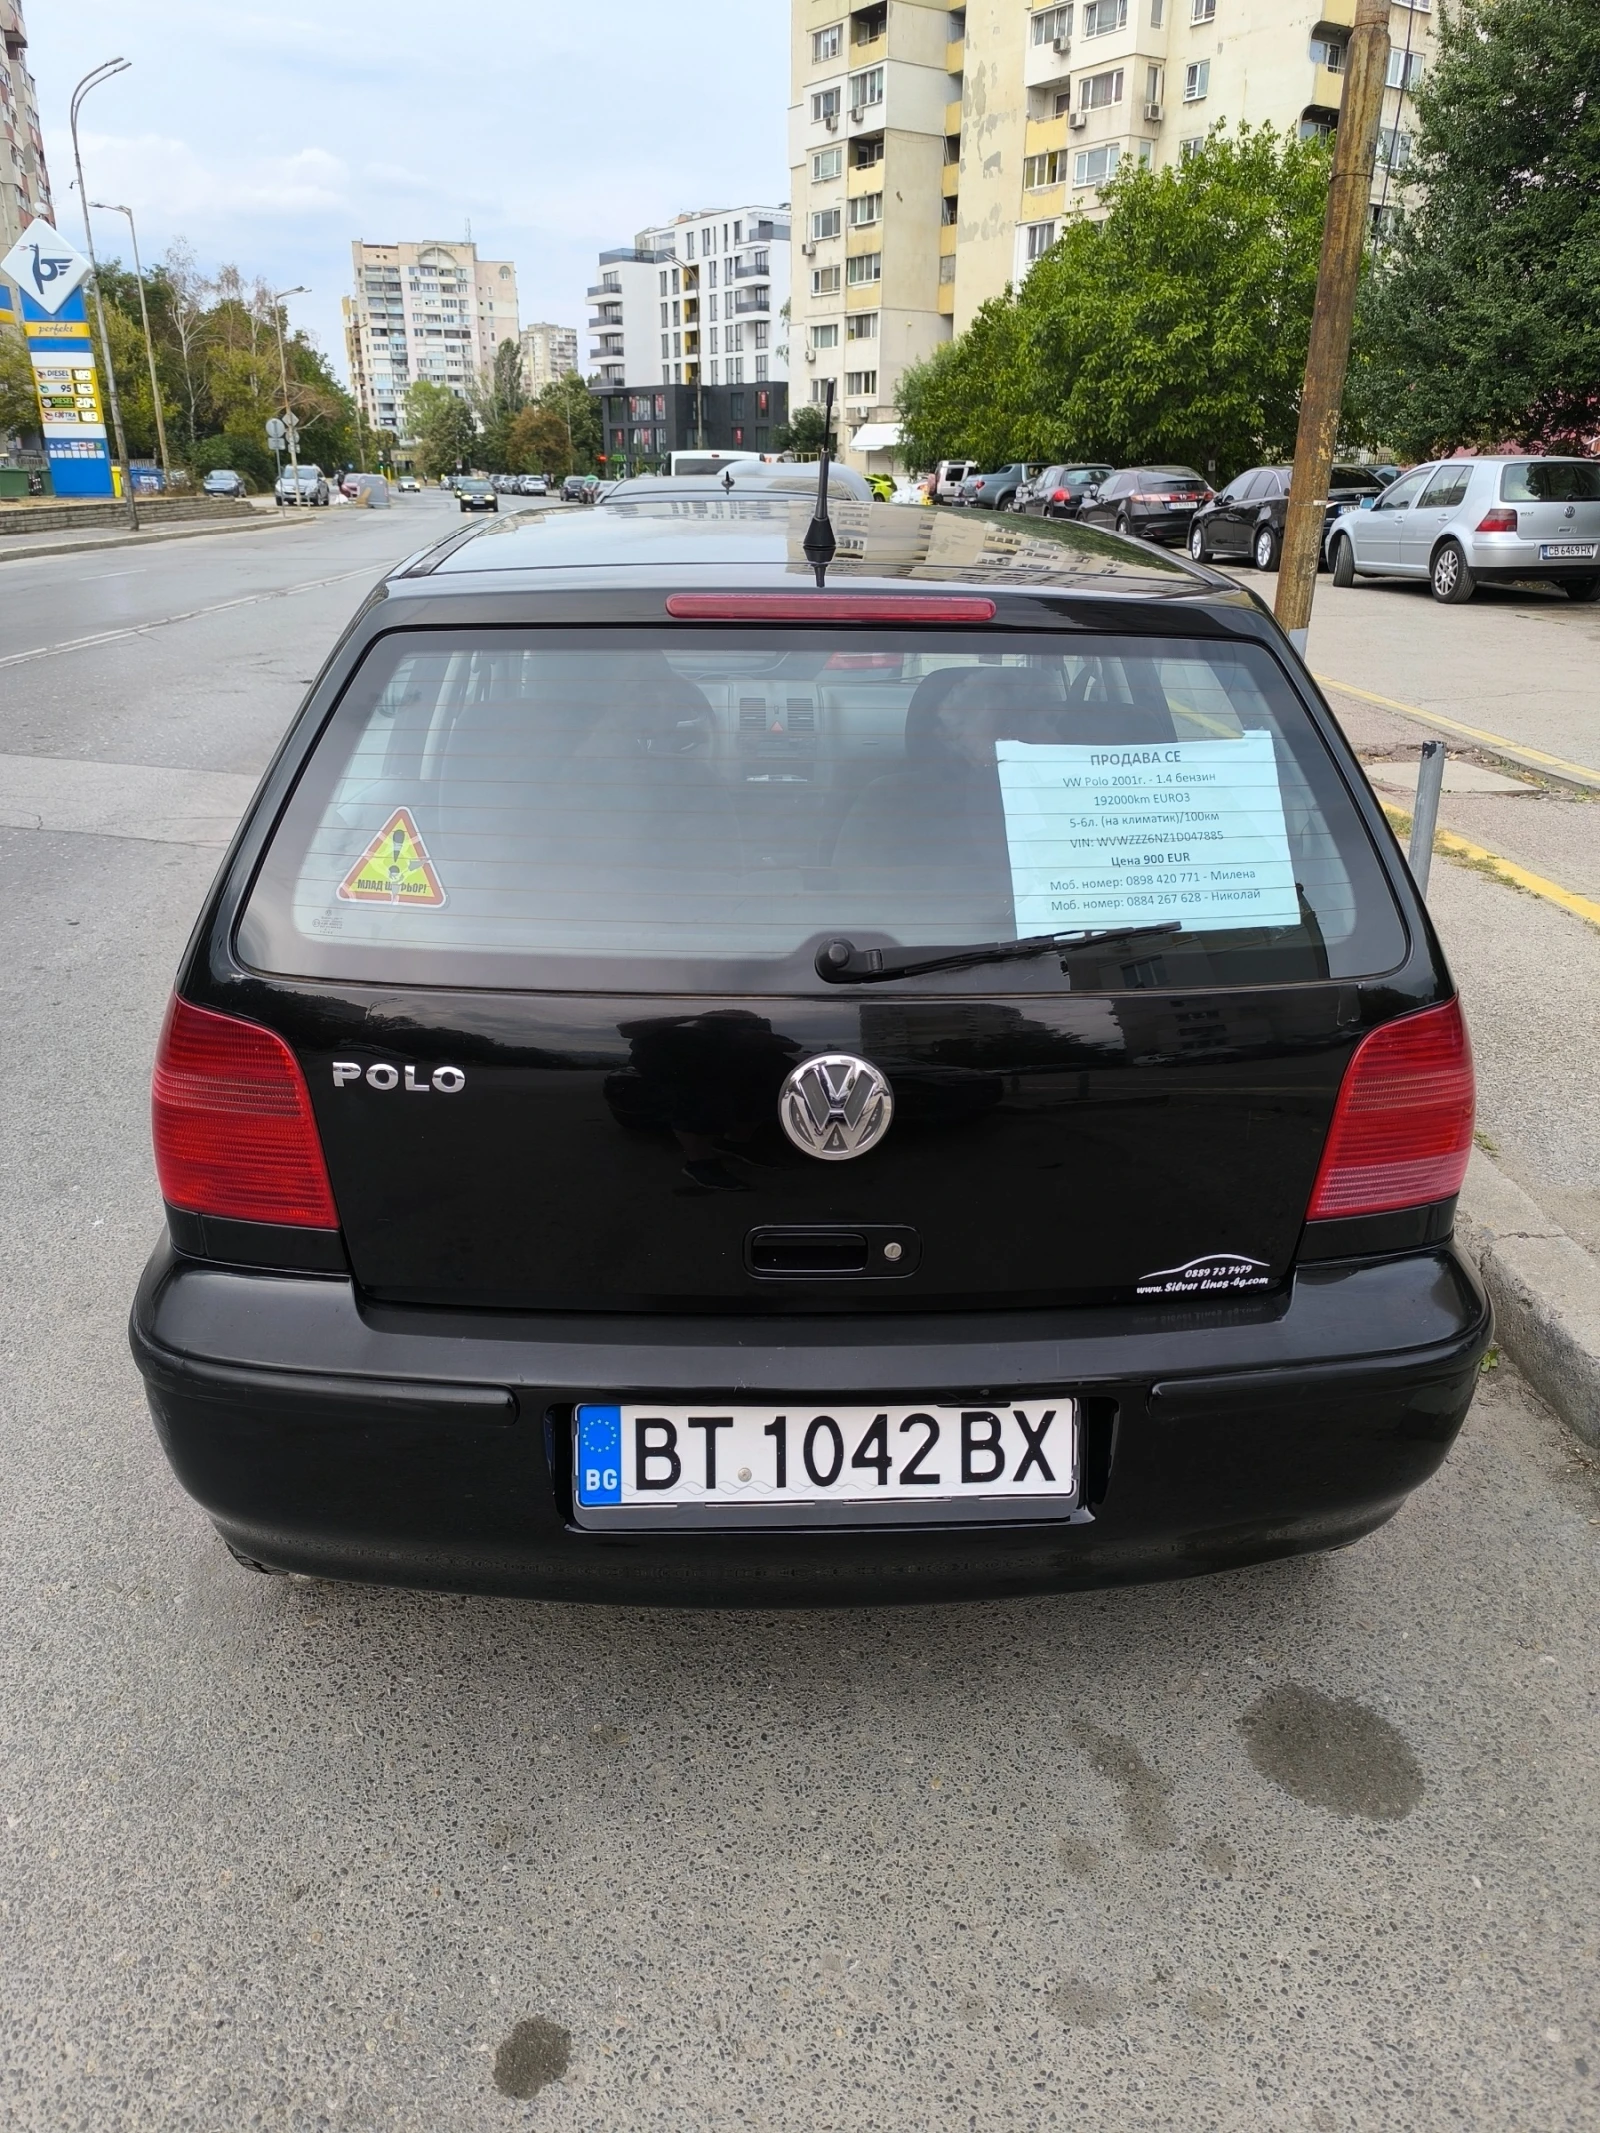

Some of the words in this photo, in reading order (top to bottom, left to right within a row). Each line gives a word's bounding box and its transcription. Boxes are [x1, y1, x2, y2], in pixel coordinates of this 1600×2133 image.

[47, 369, 69, 377] DIESEL
[60, 384, 72, 393] 95
[1090, 751, 1162, 767] ПРОДАВА
[1164, 750, 1181, 763] СЕ
[1062, 777, 1082, 788] VW
[1085, 776, 1109, 787] Polo
[1111, 775, 1146, 786] 2001г.
[1156, 774, 1172, 784] 1.4
[1175, 772, 1216, 783] бензин
[1093, 794, 1150, 806] 192000km
[1153, 792, 1190, 804] EURO3
[1069, 817, 1098, 828] 5-6л.
[1101, 815, 1119, 828] (на
[1070, 838, 1094, 849] VIN:
[1111, 855, 1141, 868] Цена
[1143, 853, 1165, 865] 900
[1167, 852, 1191, 863] EUR
[357, 878, 383, 892] МЛАД
[384, 880, 427, 894] ШФЬОР!
[1050, 878, 1079, 891] Моб.
[1082, 877, 1123, 889] номер:
[1126, 874, 1154, 886] 0898
[1156, 873, 1177, 884] 420
[1179, 872, 1200, 883] 771
[1210, 869, 1256, 881] Милена
[1051, 899, 1080, 911] Моб.
[1083, 898, 1124, 910] номер:
[1127, 895, 1154, 907] 0884
[1157, 893, 1177, 905] 267
[1180, 892, 1201, 903] 628
[1211, 889, 1261, 901] Николай
[331, 1061, 466, 1094] POLO
[1184, 1267, 1210, 1278] 0889
[1212, 1266, 1226, 1276] 73
[1228, 1264, 1253, 1275] 7479
[1164, 1282, 1199, 1292] Silver
[634, 1416, 734, 1491] BT
[763, 1412, 941, 1489] 1042
[960, 1409, 1057, 1484] BX
[585, 1468, 618, 1491] BG
